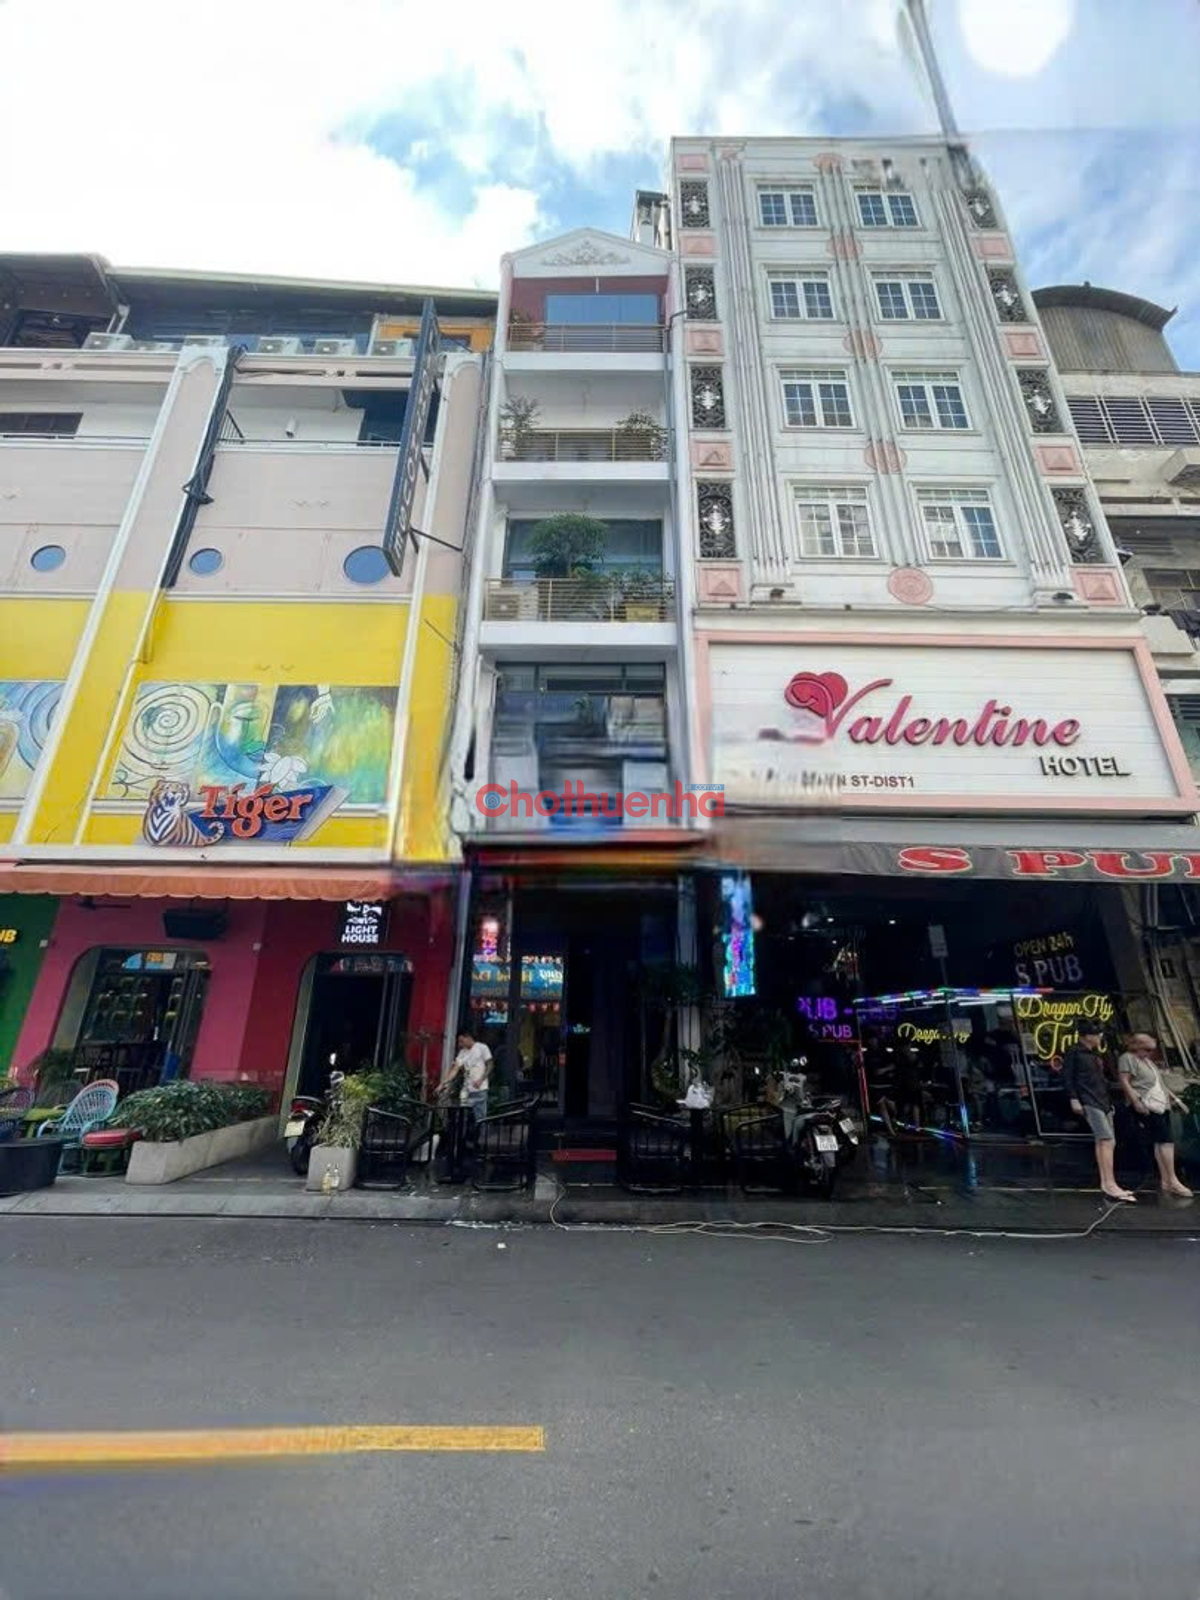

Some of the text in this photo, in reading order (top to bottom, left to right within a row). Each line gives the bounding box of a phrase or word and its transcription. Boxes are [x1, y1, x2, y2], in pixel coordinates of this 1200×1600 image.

[784, 676, 1081, 746] Valentine
[1039, 755, 1131, 777] HOTEL
[852, 774, 915, 788] ST-DIST1
[199, 782, 314, 838] Tiger
[898, 846, 973, 874] S
[341, 934, 379, 943] HOUSE
[345, 925, 378, 934] LIGHT
[1013, 939, 1047, 957] OPEN
[1033, 953, 1083, 985] PUB
[1017, 994, 1114, 1021] Dragon Fly
